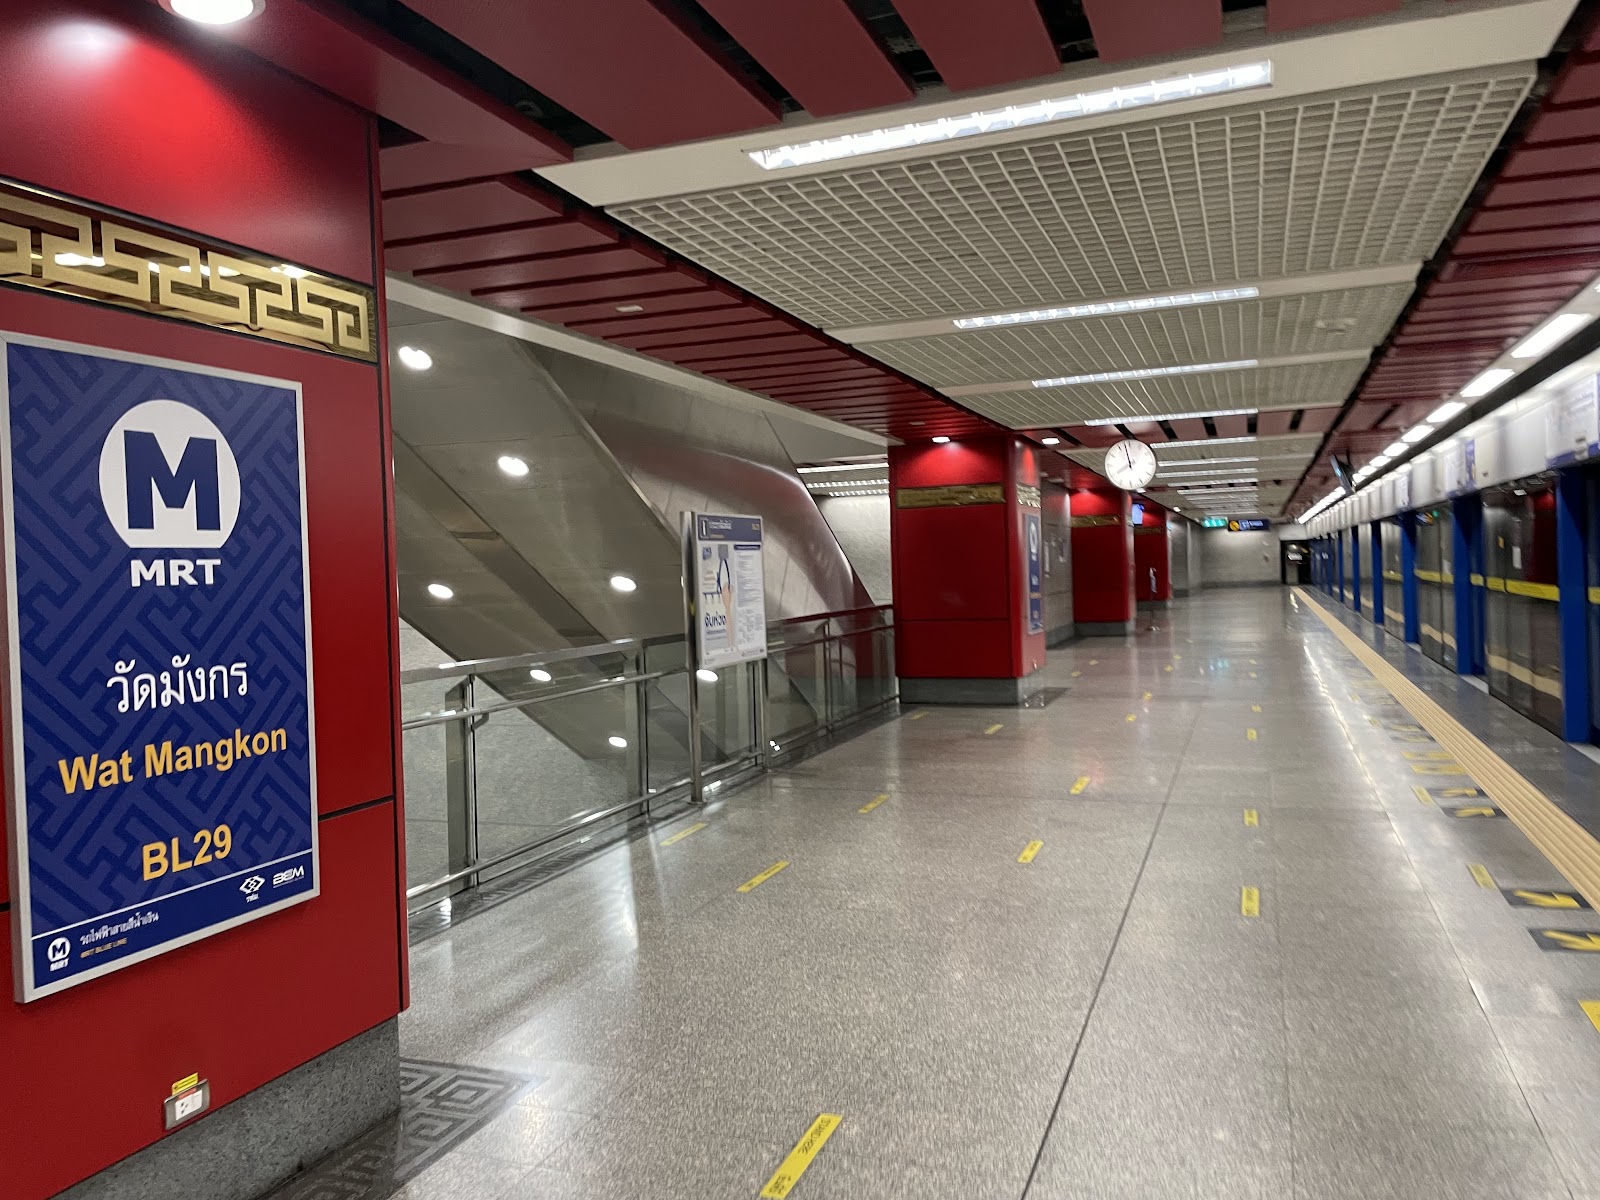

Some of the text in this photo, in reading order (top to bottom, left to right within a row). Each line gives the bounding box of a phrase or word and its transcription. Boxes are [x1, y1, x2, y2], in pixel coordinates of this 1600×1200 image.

[124, 430, 220, 531] M
[131, 558, 221, 587] MRT
[106, 653, 248, 713] วัดมังกร
[58, 728, 287, 794] Wat Mangkon
[142, 824, 232, 881] BL29
